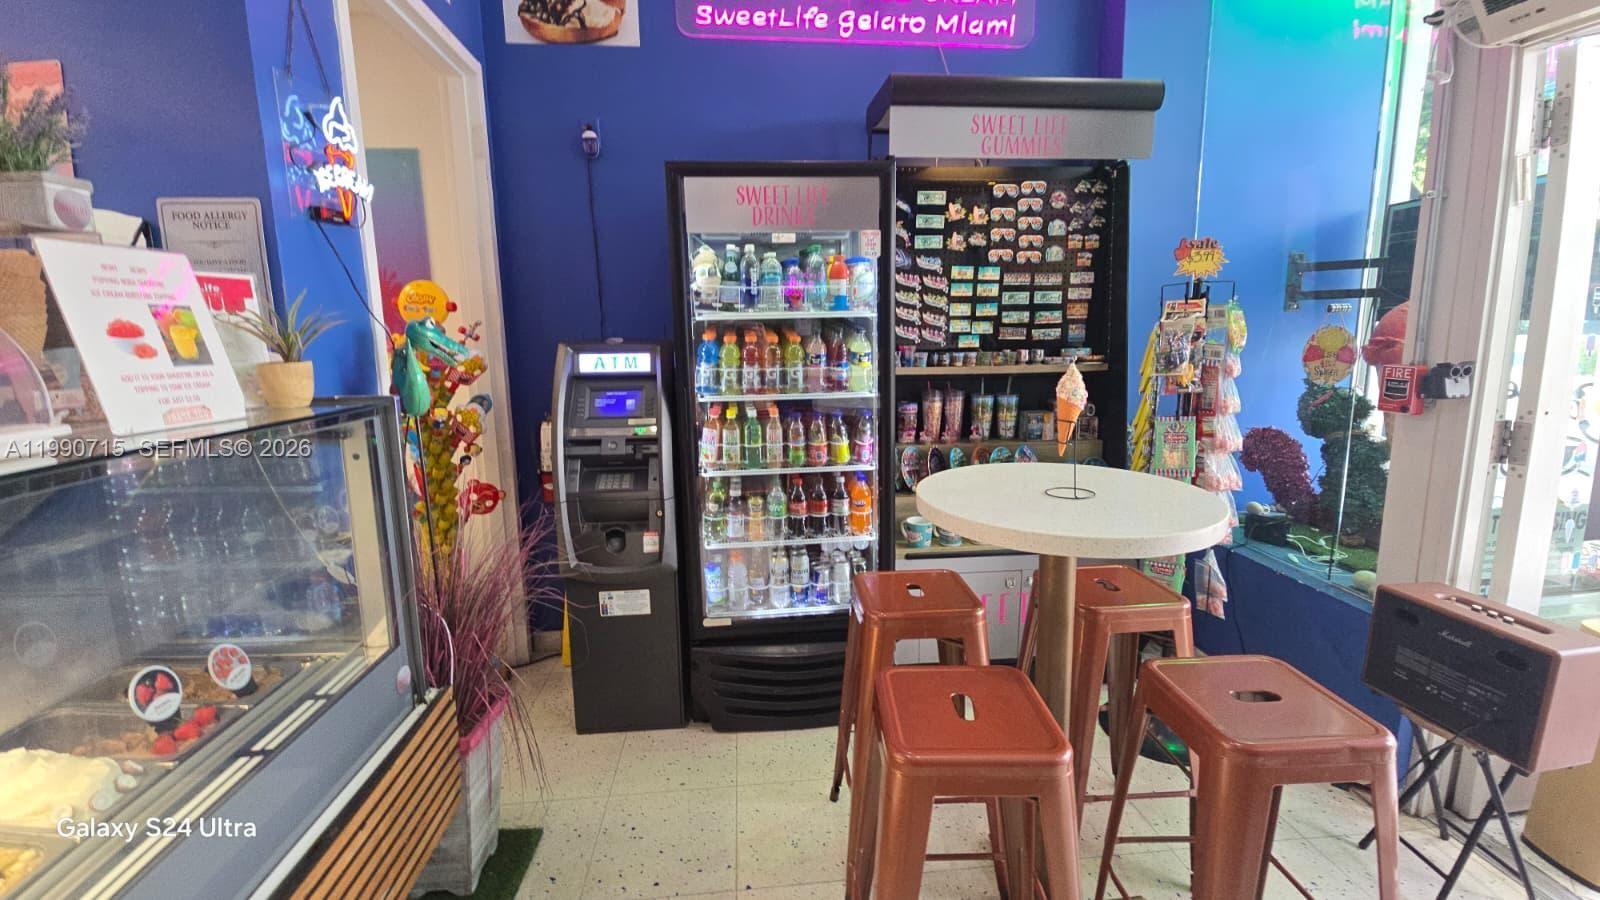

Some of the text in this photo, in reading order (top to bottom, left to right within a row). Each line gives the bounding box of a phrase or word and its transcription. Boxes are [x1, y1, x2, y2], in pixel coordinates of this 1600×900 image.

[838, 10, 926, 38] gelato
[970, 112, 1025, 135] SWEET
[981, 135, 1063, 156] GUMMIES
[736, 184, 790, 207] SWEET
[172, 210, 248, 221] FOOD ALLERGY
[192, 220, 232, 230] NOTICE
[752, 206, 816, 227] DRINKS
[594, 356, 638, 369] ATM
[1384, 367, 1412, 379] FIRE
